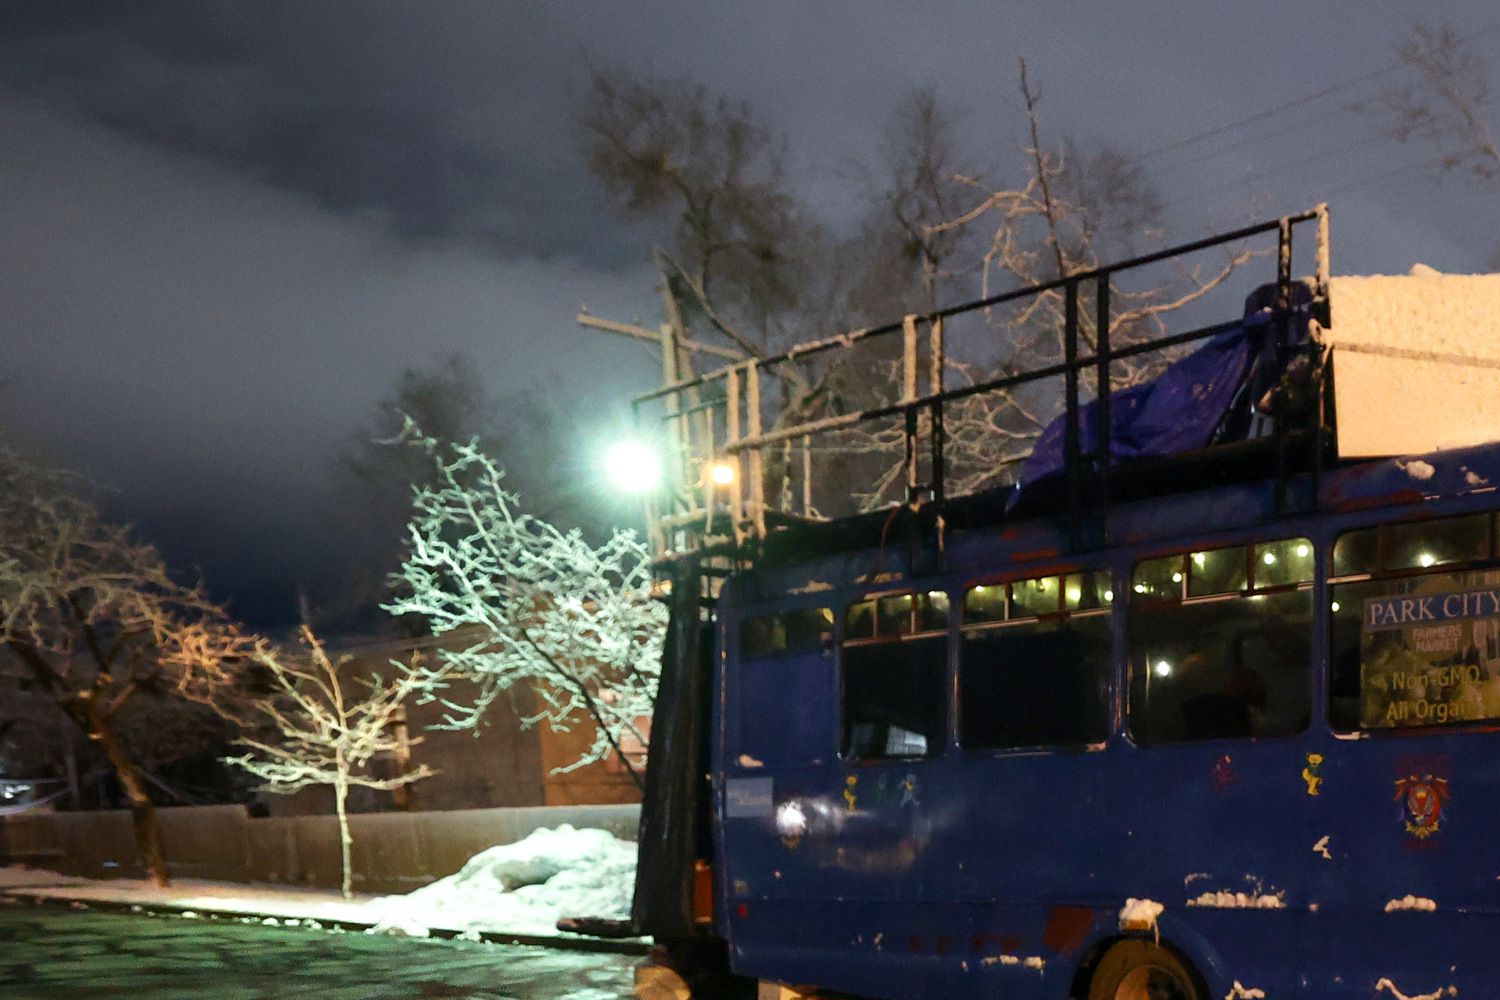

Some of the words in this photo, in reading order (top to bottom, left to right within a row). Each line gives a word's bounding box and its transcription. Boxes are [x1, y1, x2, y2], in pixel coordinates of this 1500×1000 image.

[1369, 597, 1436, 625] PARK
[1412, 623, 1463, 640] FARMERS
[1416, 637, 1459, 652] MARKET
[1392, 665, 1480, 690] Non-GMO
